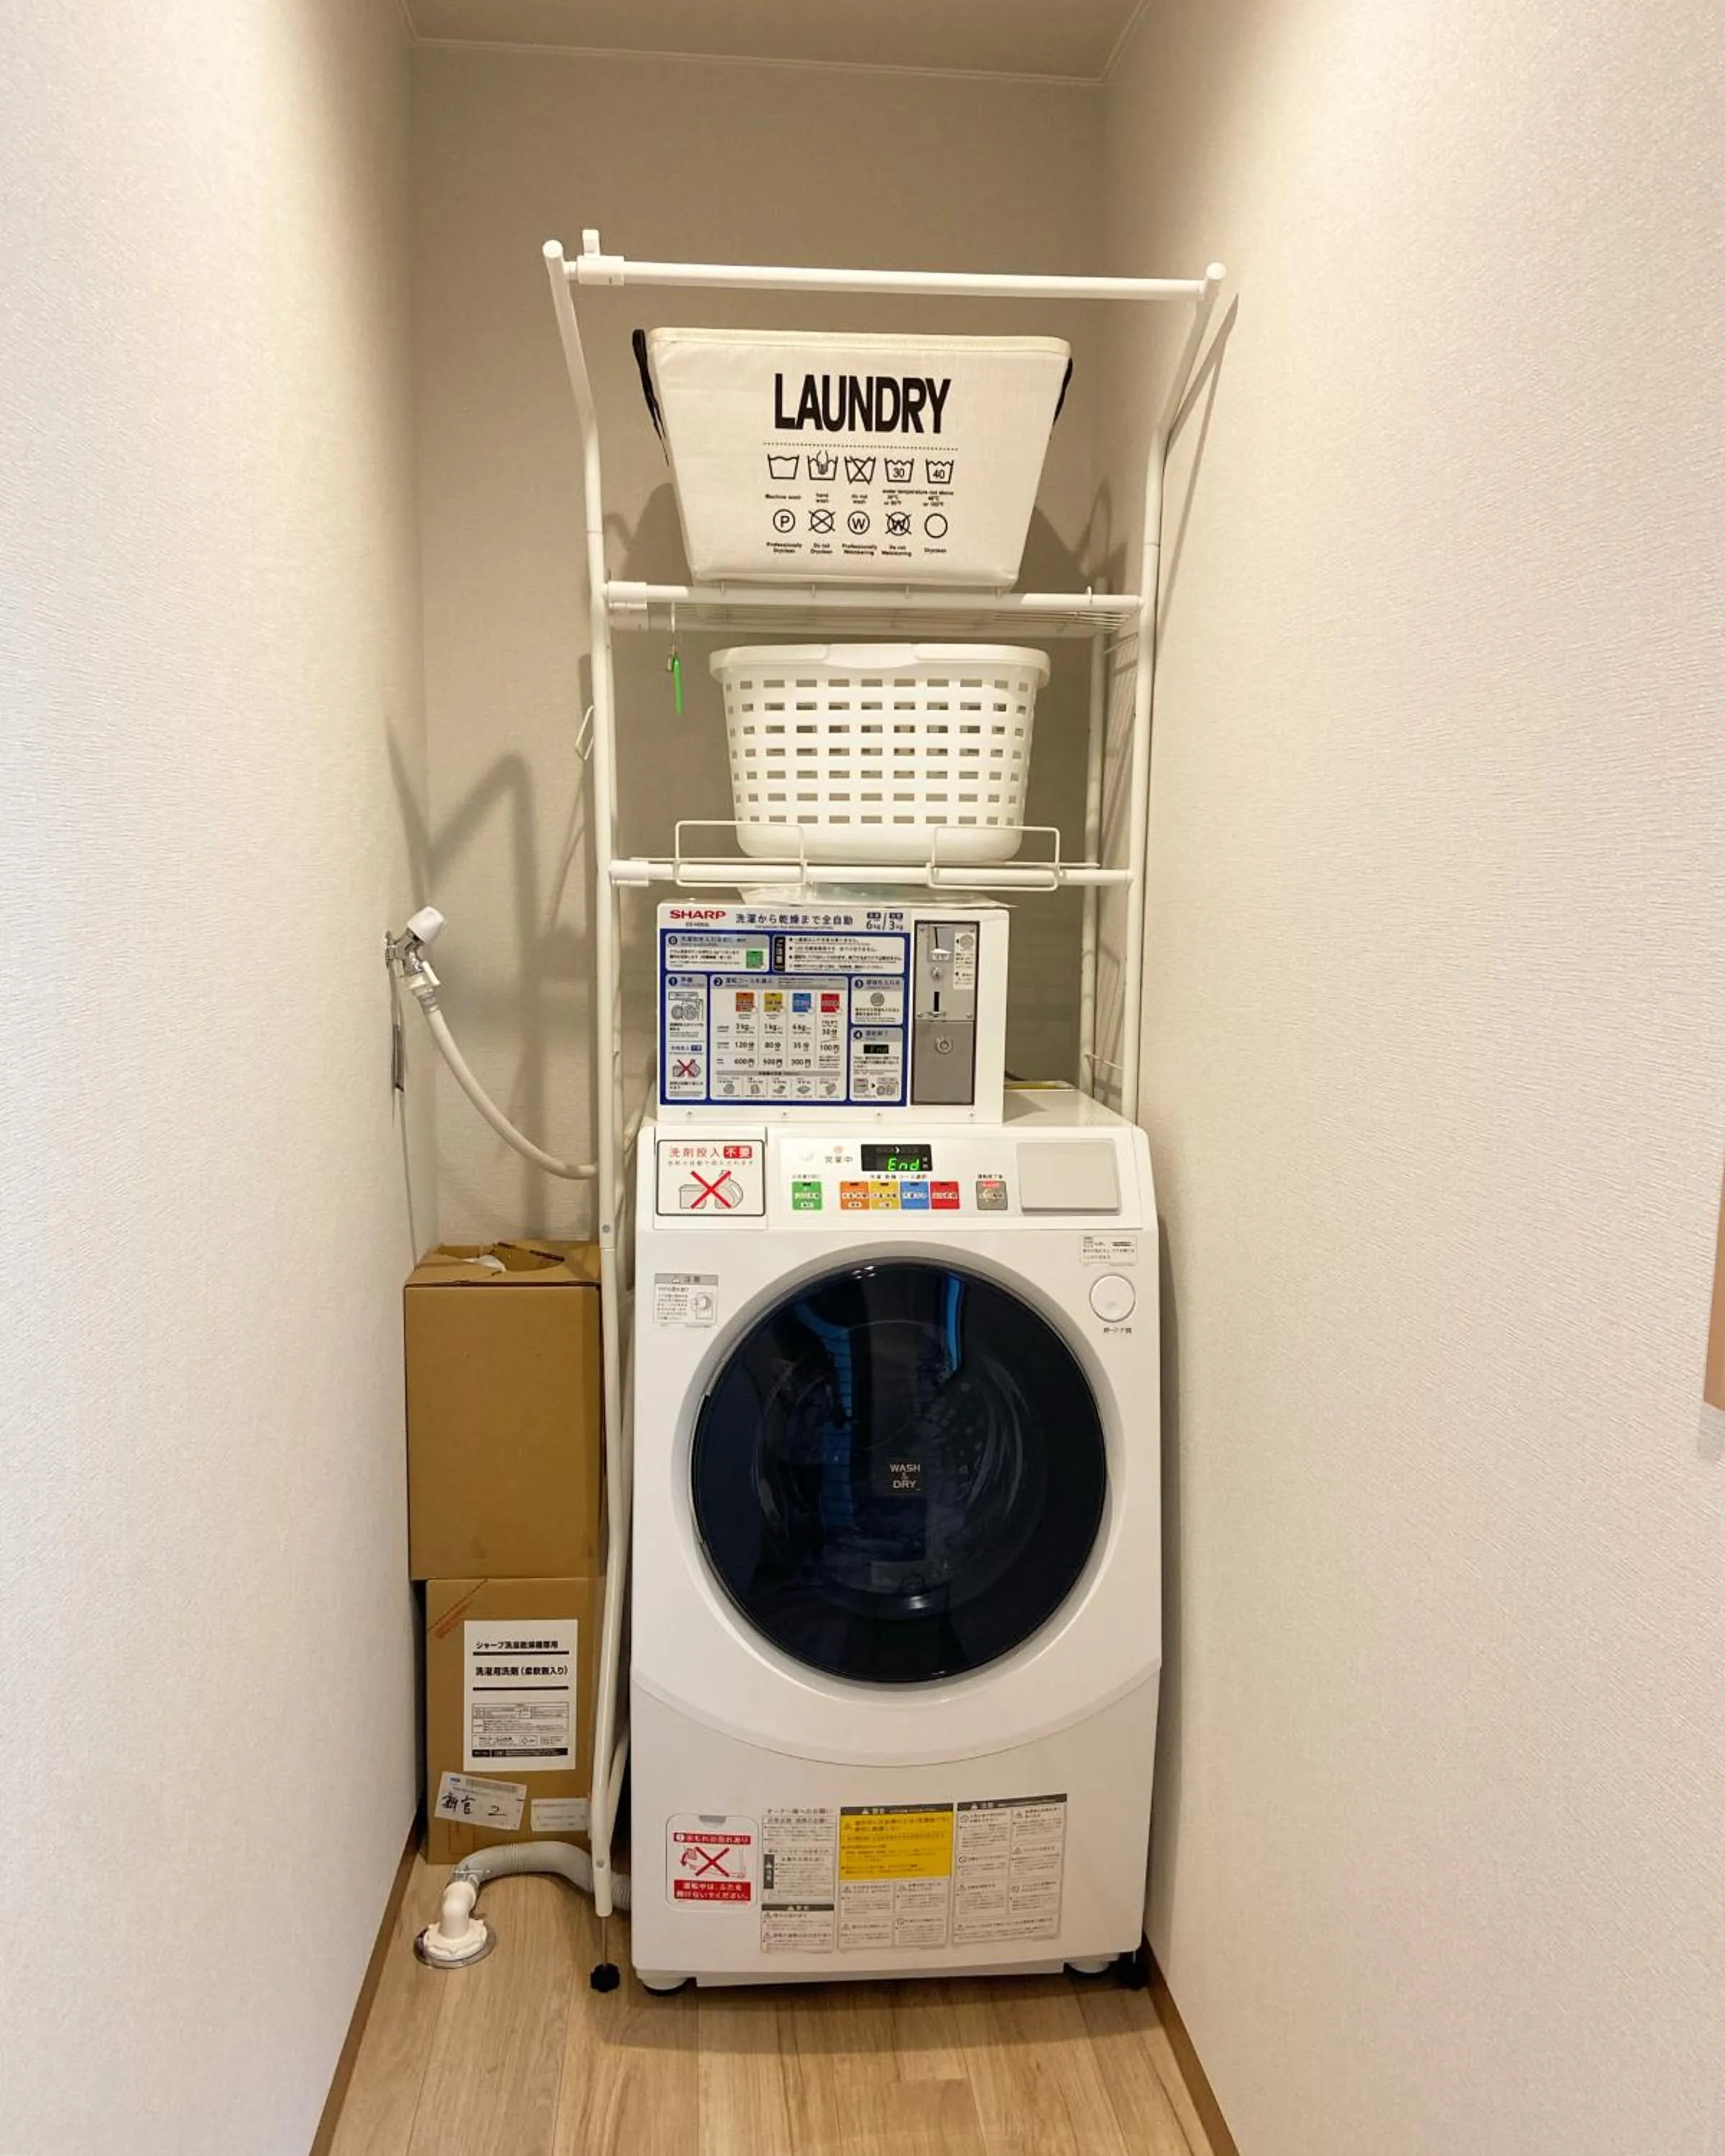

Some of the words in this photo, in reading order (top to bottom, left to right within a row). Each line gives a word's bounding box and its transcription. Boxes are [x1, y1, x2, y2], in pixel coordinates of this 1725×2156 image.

[774, 373, 951, 433] LAUNDRY
[893, 469, 905, 478] 30
[932, 469, 945, 479] 40
[780, 516, 791, 528] P
[852, 519, 866, 530] W
[669, 909, 727, 919] SHARP
[735, 914, 853, 925] 洗濯から乾燥まで全自動
[888, 1158, 919, 1171] End
[889, 1463, 921, 1473] WASH
[893, 1480, 917, 1489] DRY
